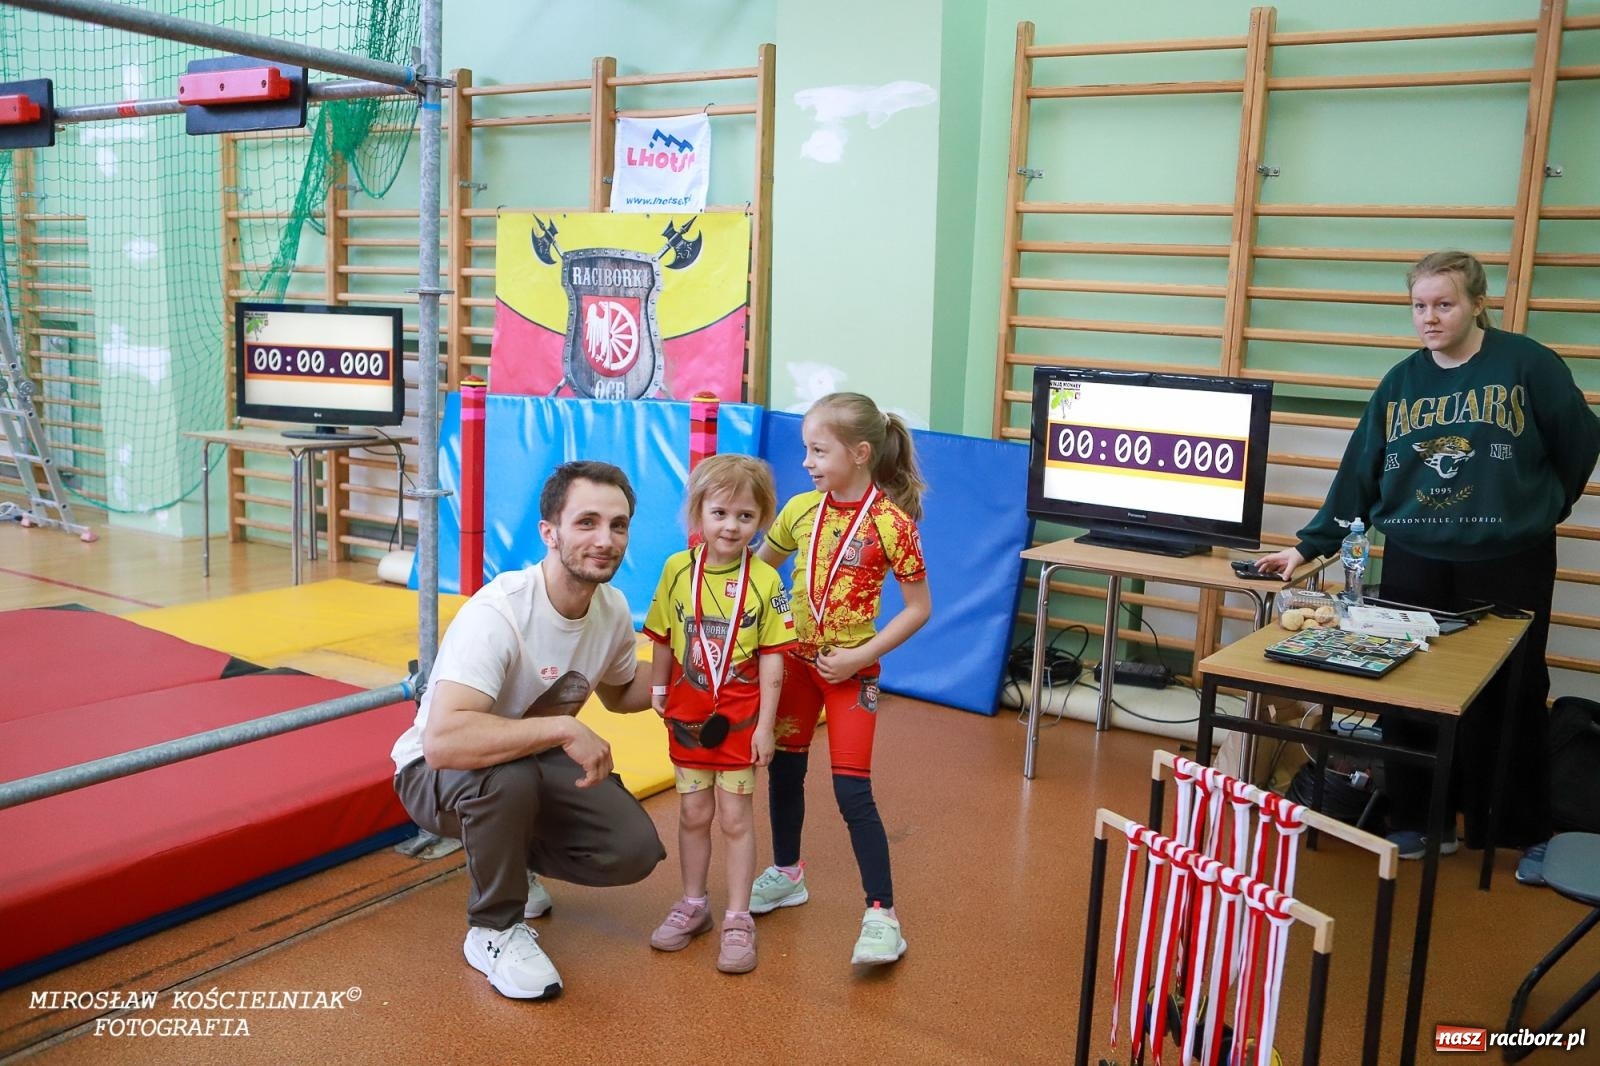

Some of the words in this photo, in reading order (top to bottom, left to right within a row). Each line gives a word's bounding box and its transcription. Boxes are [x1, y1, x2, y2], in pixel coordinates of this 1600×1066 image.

[254, 347, 383, 376] 00:00.000
[1386, 384, 1525, 443] JAGUARS
[1058, 428, 1234, 474] 00:00.000
[1490, 443, 1513, 460] NFL
[1430, 487, 1453, 495] 1995
